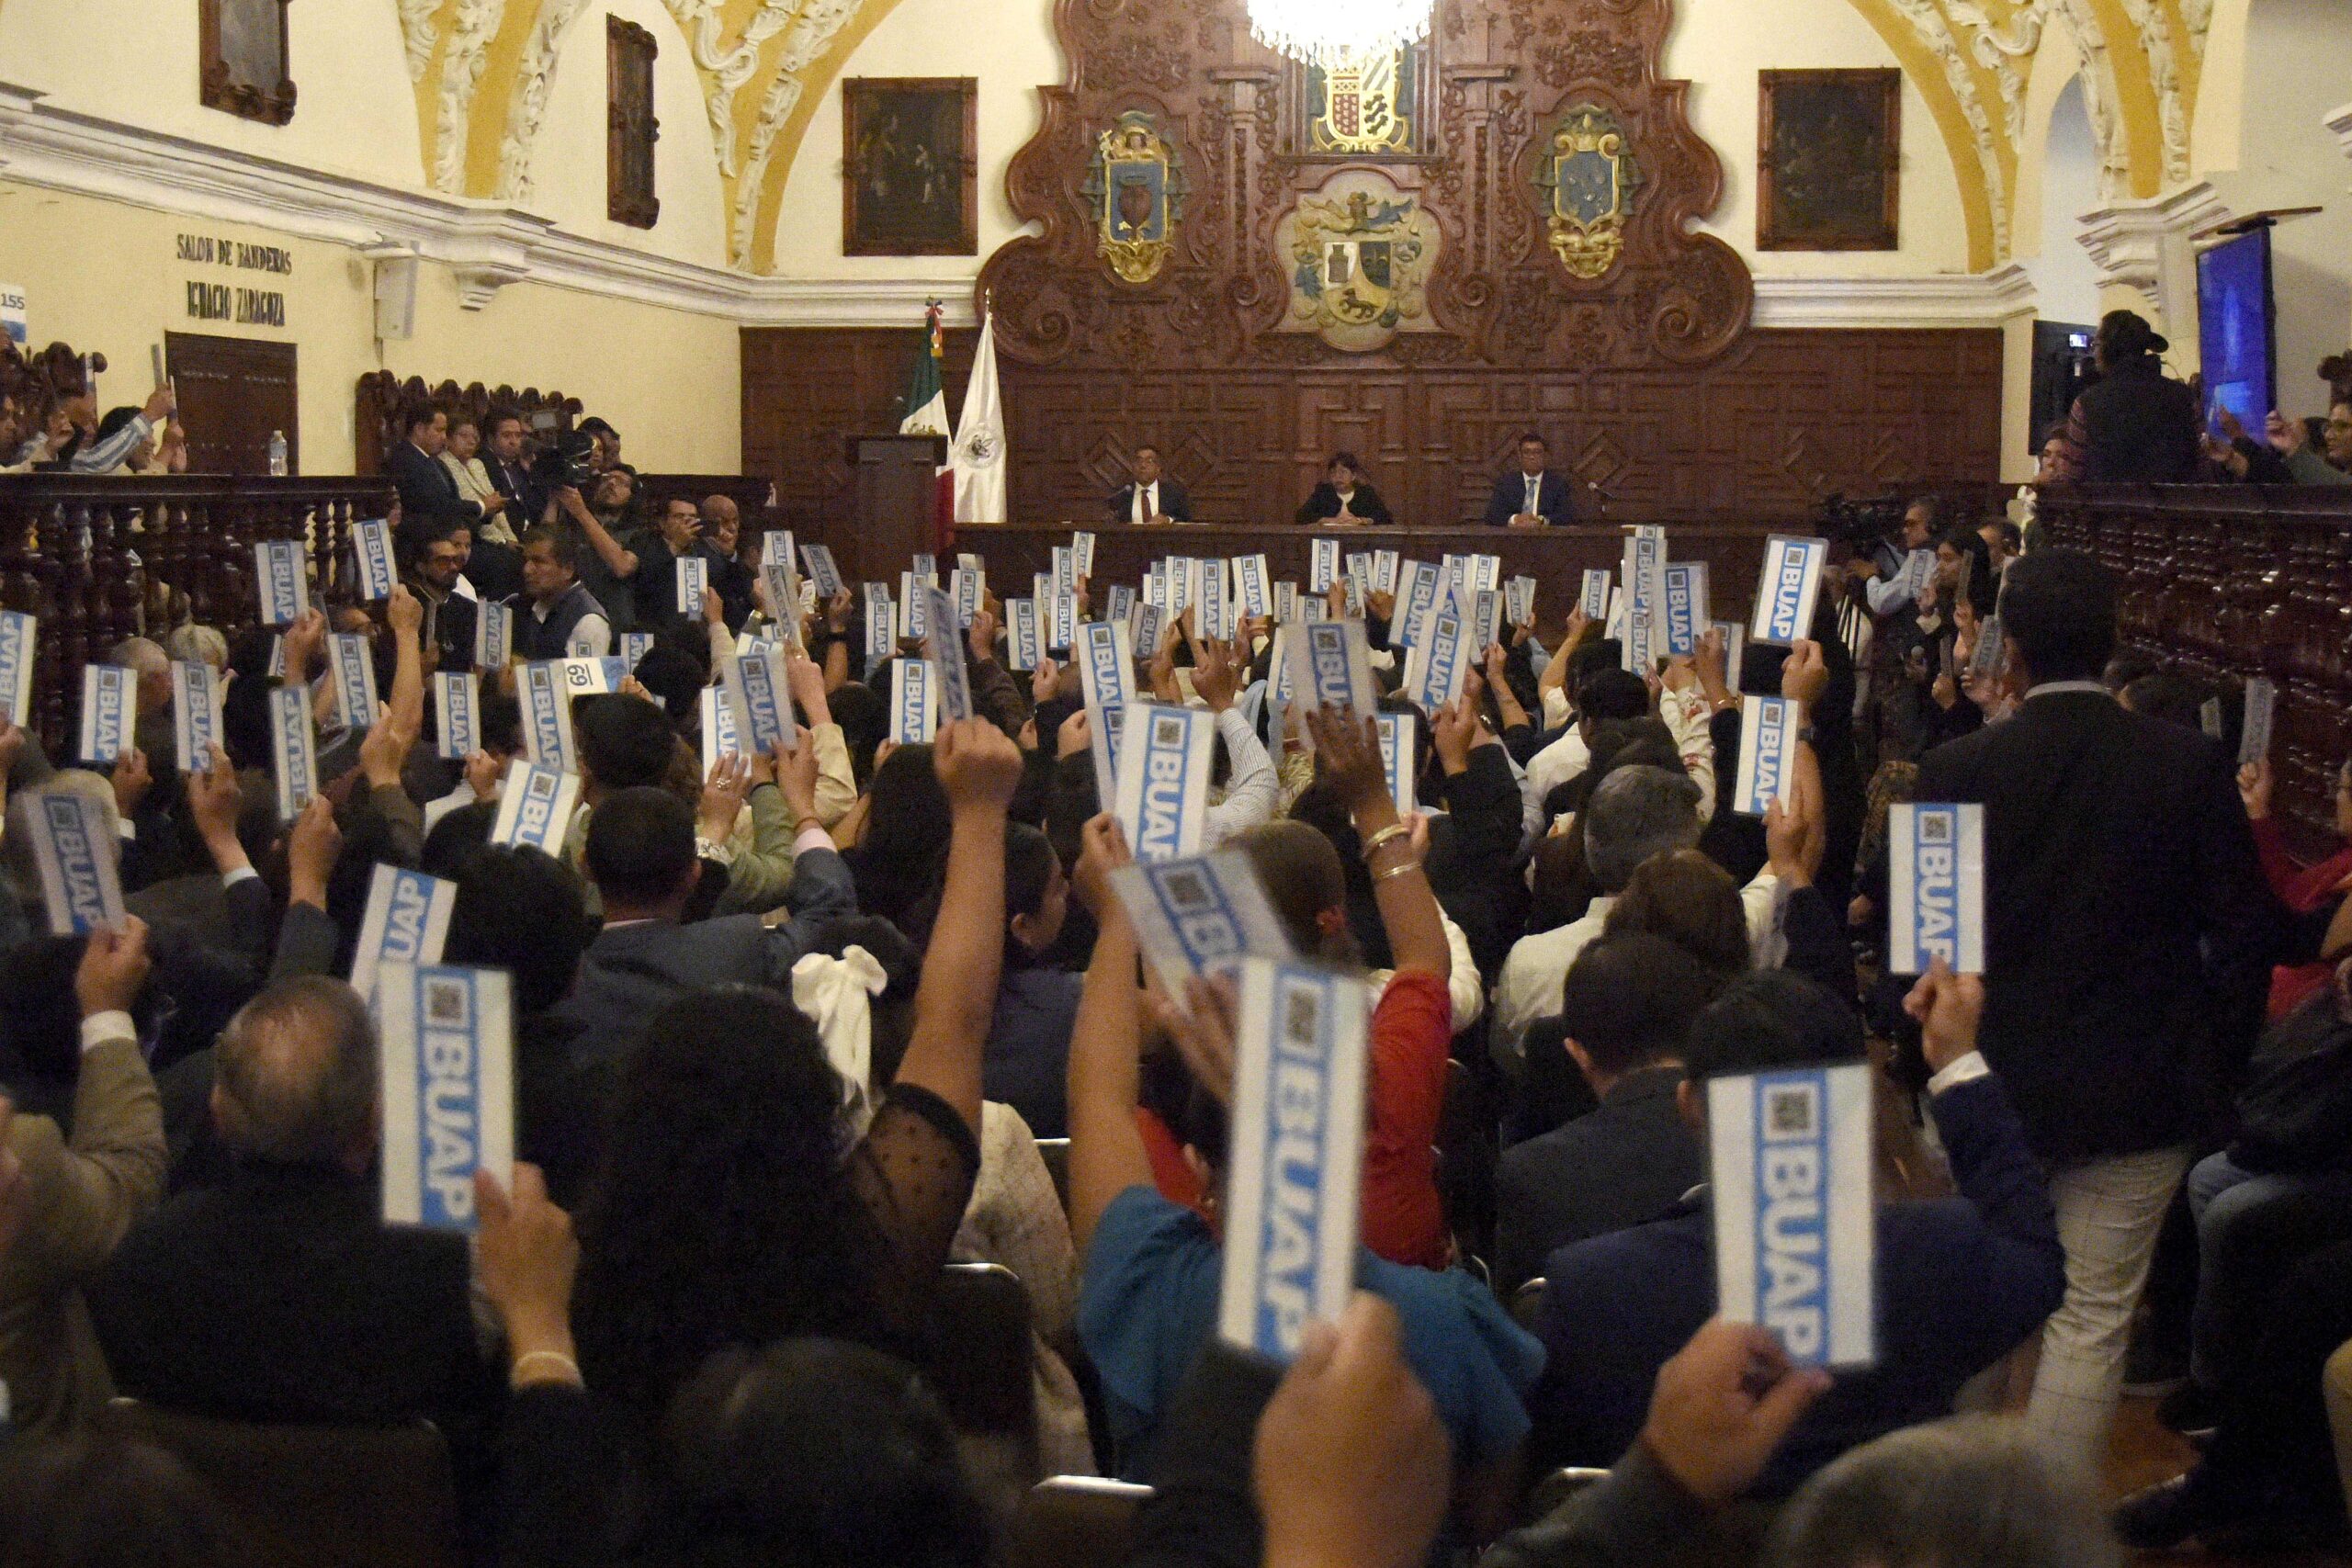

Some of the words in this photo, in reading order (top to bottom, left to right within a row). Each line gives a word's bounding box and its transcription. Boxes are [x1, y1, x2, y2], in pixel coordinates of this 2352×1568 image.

[218, 239, 232, 265] DE
[1, 293, 25, 310] 155
[187, 280, 232, 321] IGNACIO
[274, 561, 295, 620] BUAP
[368, 539, 389, 595] BUAP
[687, 570, 699, 611] BUAP
[1060, 562, 1071, 594] BUAP
[1244, 570, 1261, 614] BUAP
[1319, 554, 1330, 591] BUAP
[1637, 555, 1653, 607] BUAP
[960, 585, 975, 626] BUAP
[1205, 581, 1218, 637] BUAP
[1588, 581, 1601, 616] BUAP
[1668, 591, 1690, 651] BUAP
[1771, 567, 1803, 637] BUAP
[875, 616, 887, 654] BUAP
[1019, 617, 1036, 668] BUAP
[1058, 608, 1069, 646] BUAP
[345, 660, 368, 724] BUAP
[567, 664, 588, 686] 69
[1094, 647, 1122, 706] BUA
[1426, 638, 1454, 705] BUAP
[98, 692, 119, 759] BUAP
[285, 692, 307, 782] BUAP
[905, 682, 923, 742] BUAP
[515, 799, 550, 848] BU
[386, 875, 426, 962] UAP
[424, 1032, 475, 1221] BUAP
[1762, 1145, 1823, 1357] BUAP
